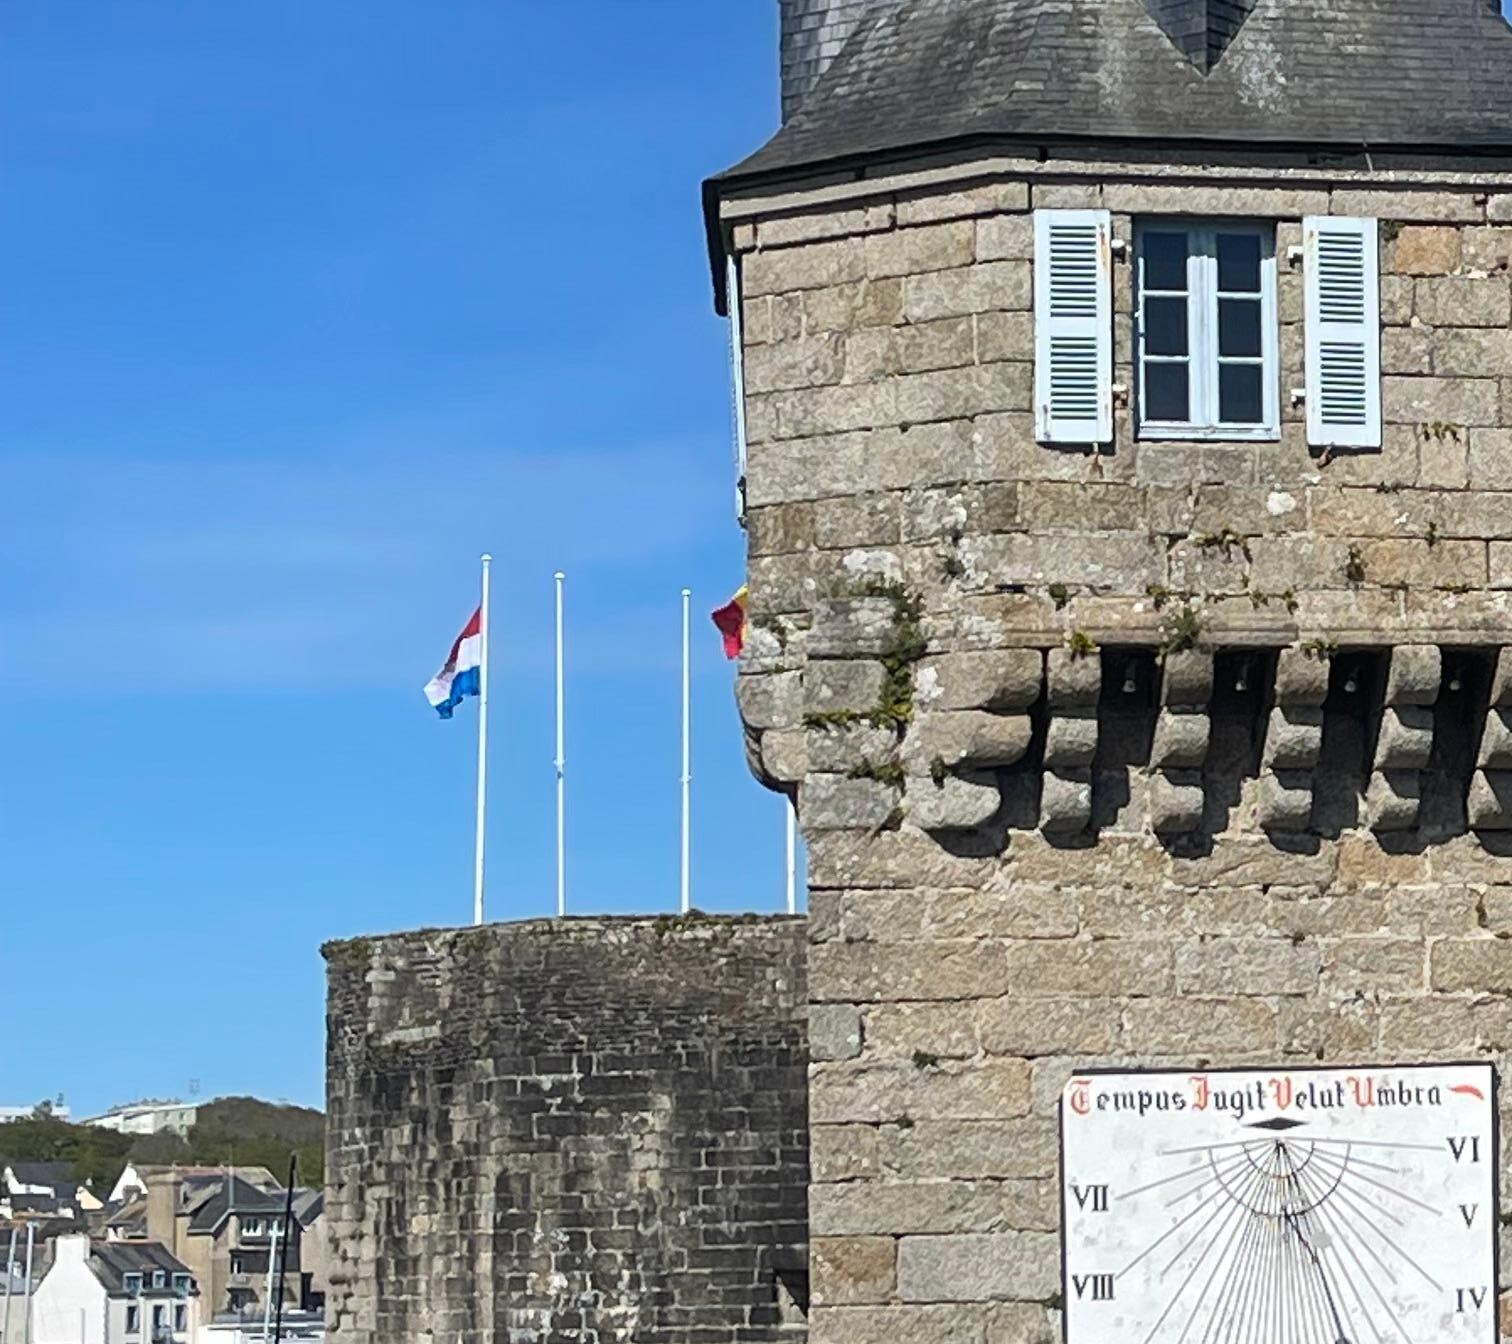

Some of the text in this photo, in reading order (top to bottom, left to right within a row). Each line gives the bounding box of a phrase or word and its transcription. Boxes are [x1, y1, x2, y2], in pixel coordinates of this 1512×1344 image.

[1070, 1079, 1187, 1117] Tempus
[1268, 1076, 1345, 1111] Velut
[1346, 1076, 1442, 1107] Umbra
[1446, 1136, 1481, 1163] VI
[1071, 1184, 1110, 1212] VII
[1458, 1203, 1479, 1229] V
[1072, 1273, 1116, 1301] VIII
[1455, 1286, 1487, 1313] IV
